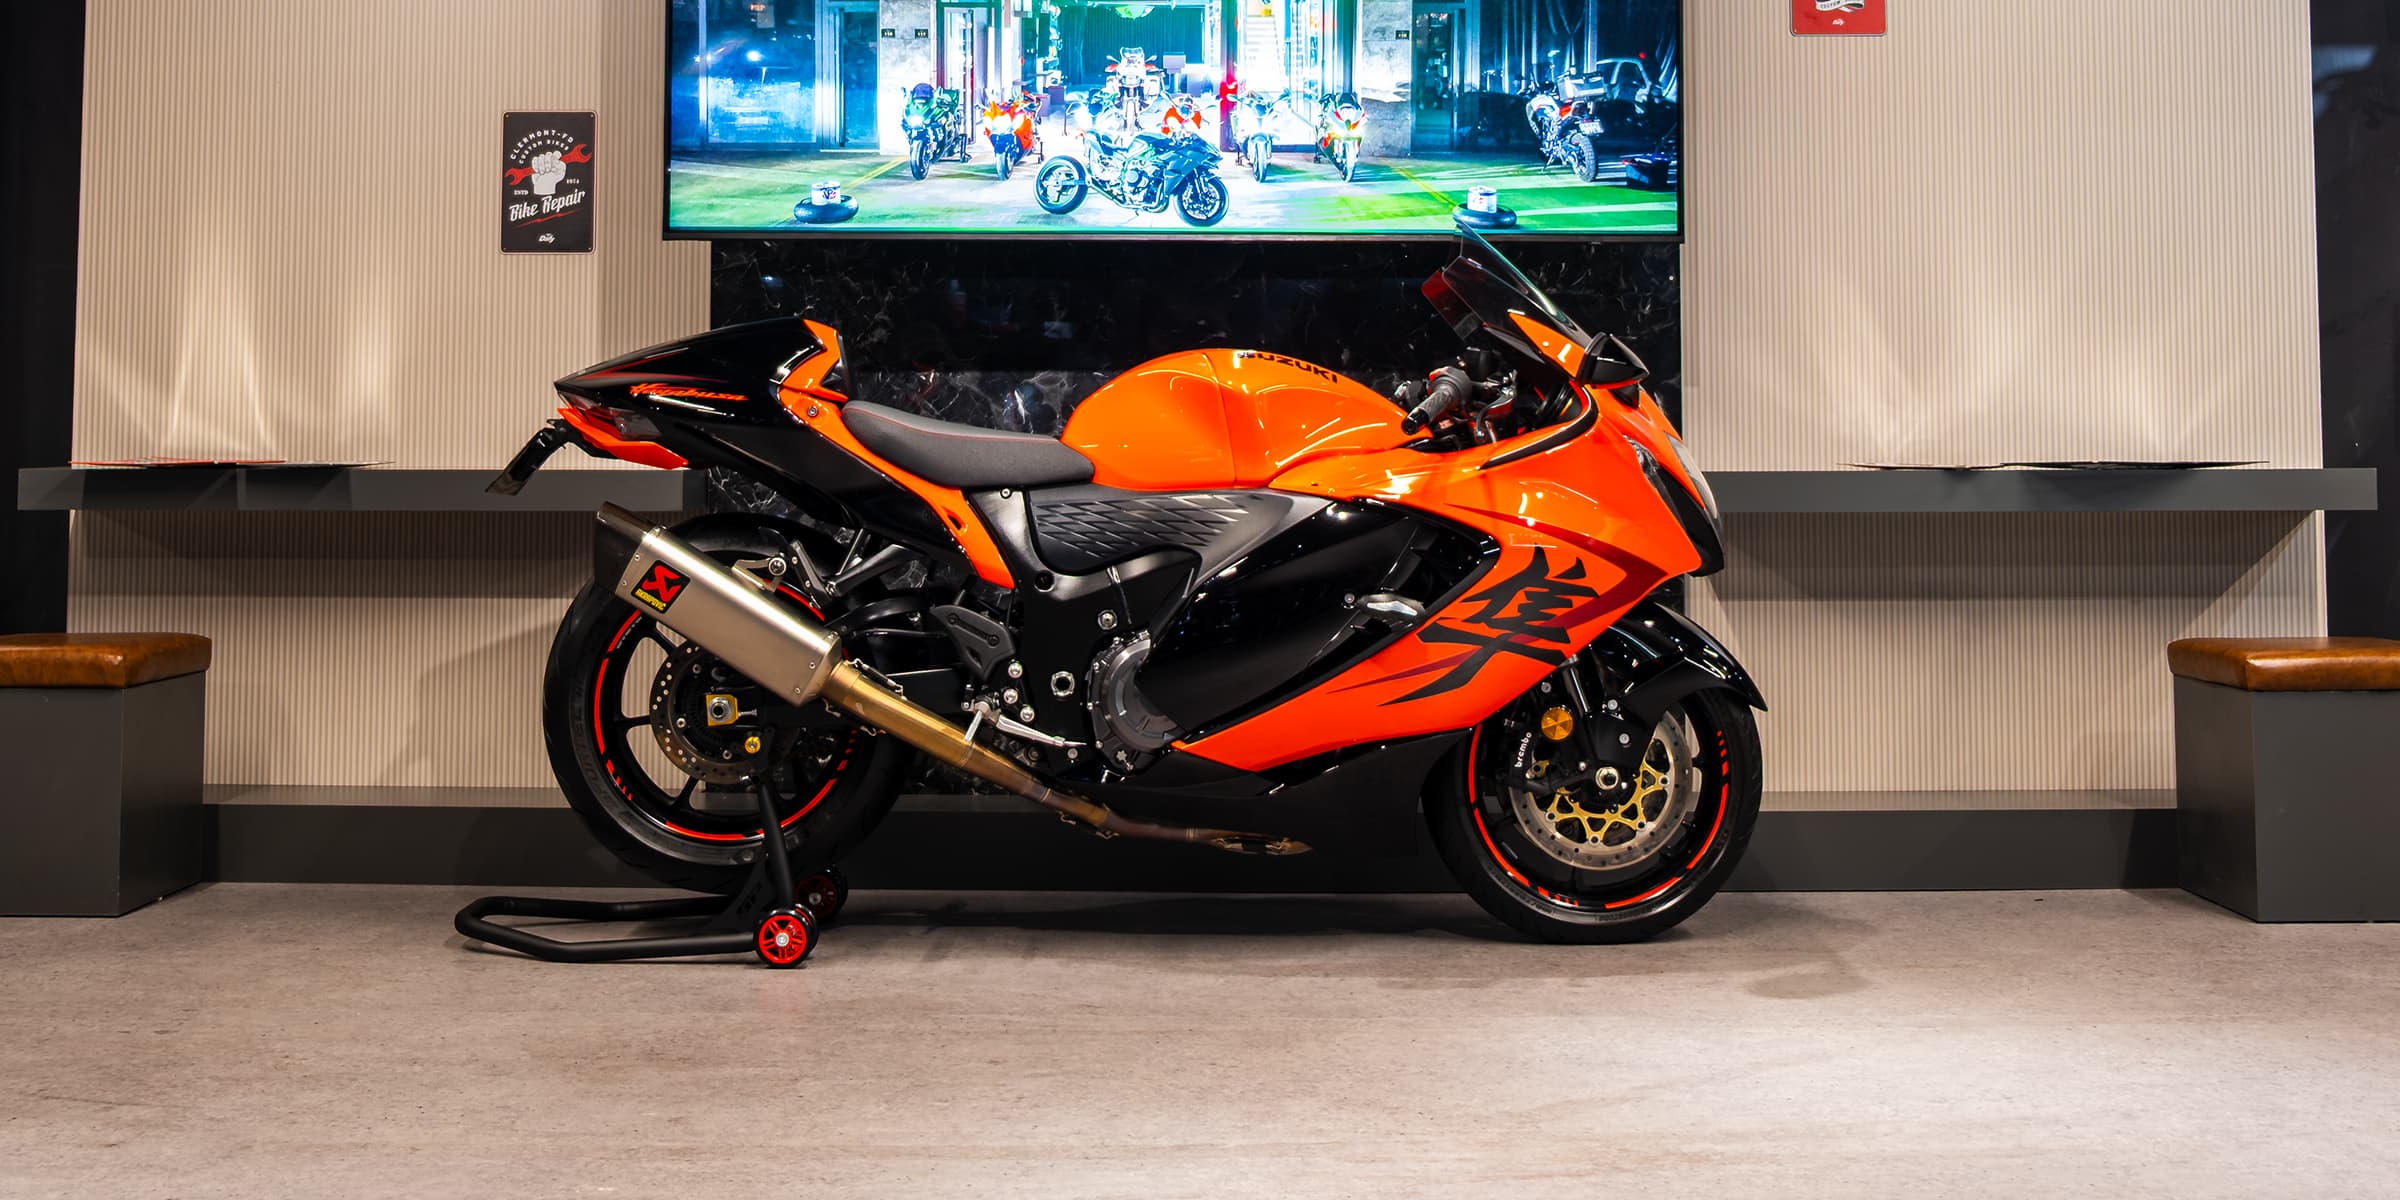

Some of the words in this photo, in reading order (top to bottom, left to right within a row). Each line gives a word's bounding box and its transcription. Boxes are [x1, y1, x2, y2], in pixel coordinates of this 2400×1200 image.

[509, 202, 540, 221] Bike
[542, 189, 586, 213] Repair
[1376, 543, 1600, 706] 隼
[1513, 731, 1532, 768] brembo
